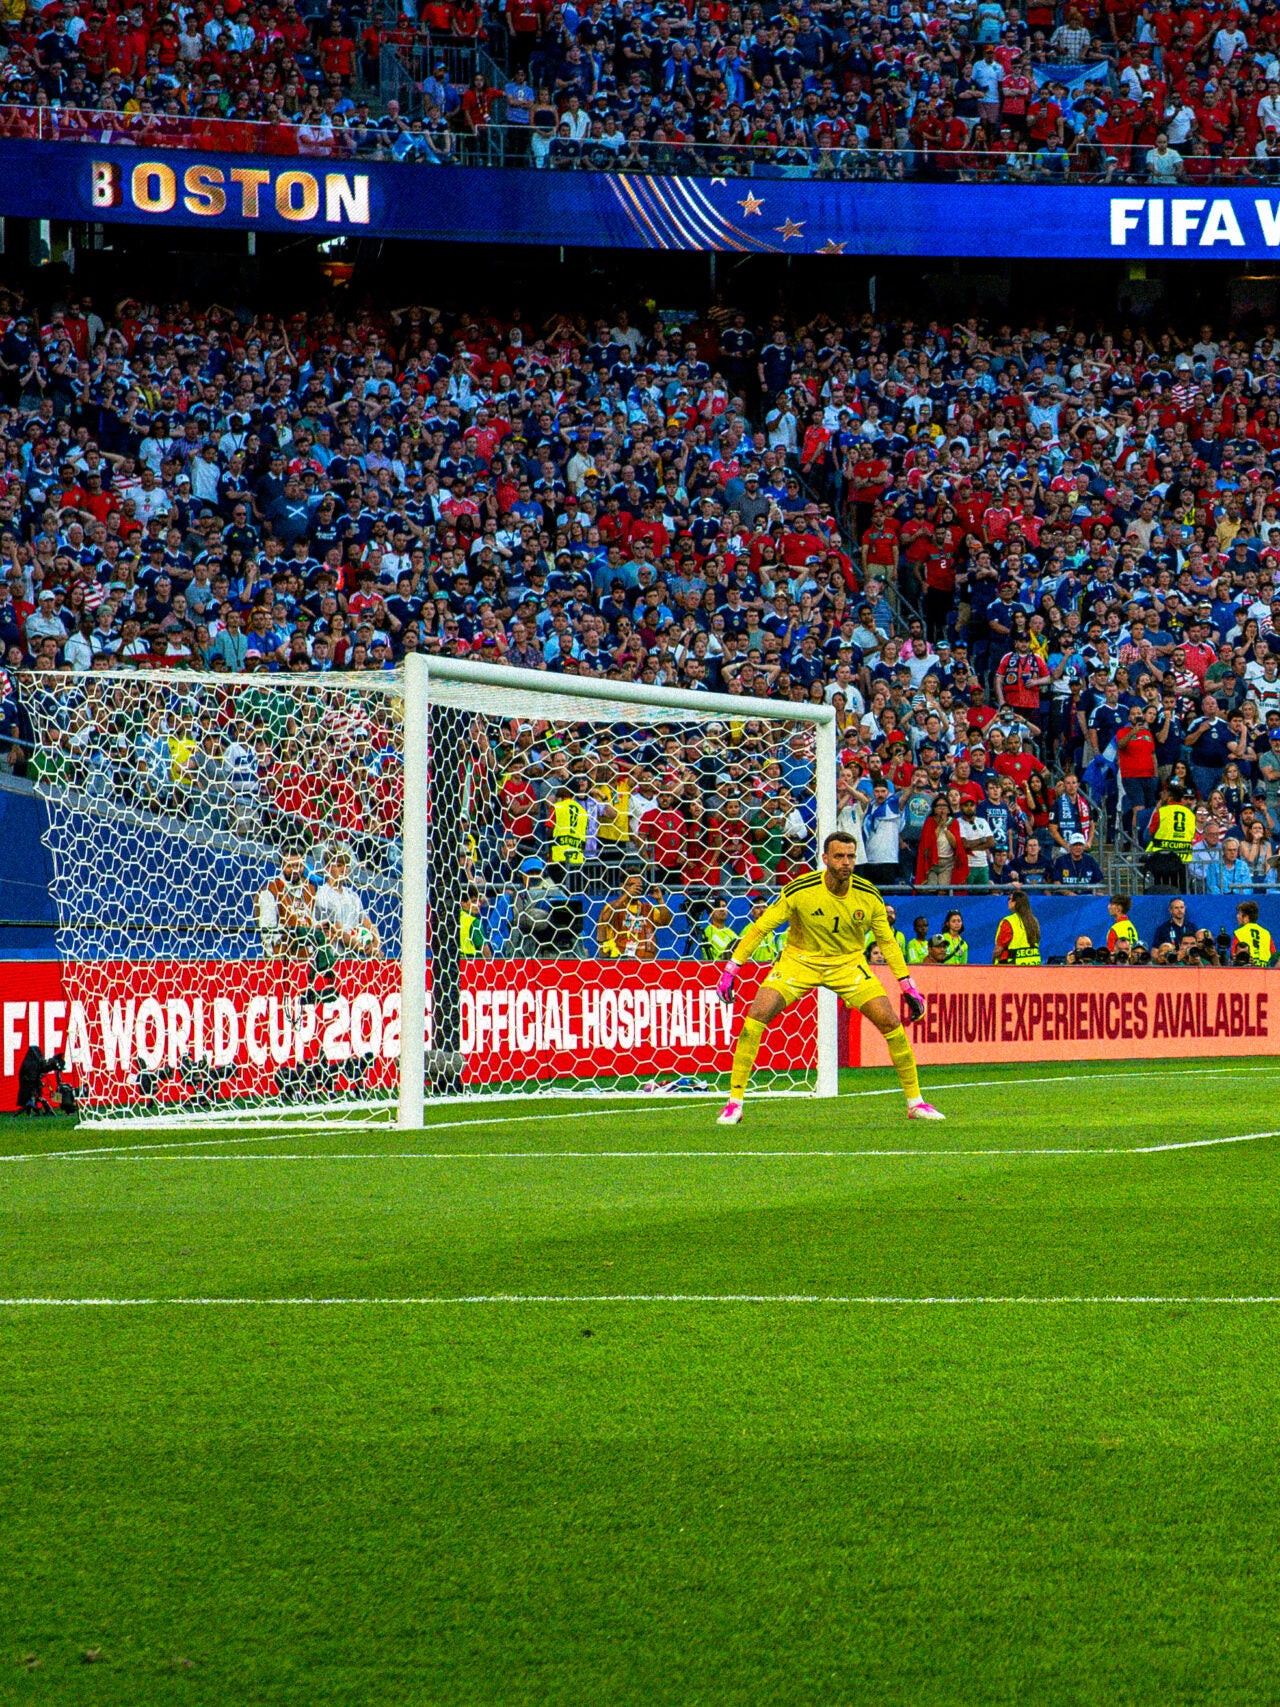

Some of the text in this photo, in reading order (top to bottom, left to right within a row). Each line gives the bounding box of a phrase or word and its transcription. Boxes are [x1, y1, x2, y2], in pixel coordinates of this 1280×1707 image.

[92, 161, 370, 224] BOSTON
[1110, 199, 1246, 246] FIFA
[831, 916, 840, 933] 1
[857, 964, 871, 980] 1
[3, 992, 433, 1077] FIFA WORLD CUP 202
[460, 988, 734, 1055] OFFICIAL HOSPITALITY
[1000, 992, 1148, 1042] EXPERIENCES
[1153, 992, 1269, 1039] AVAILABLE
